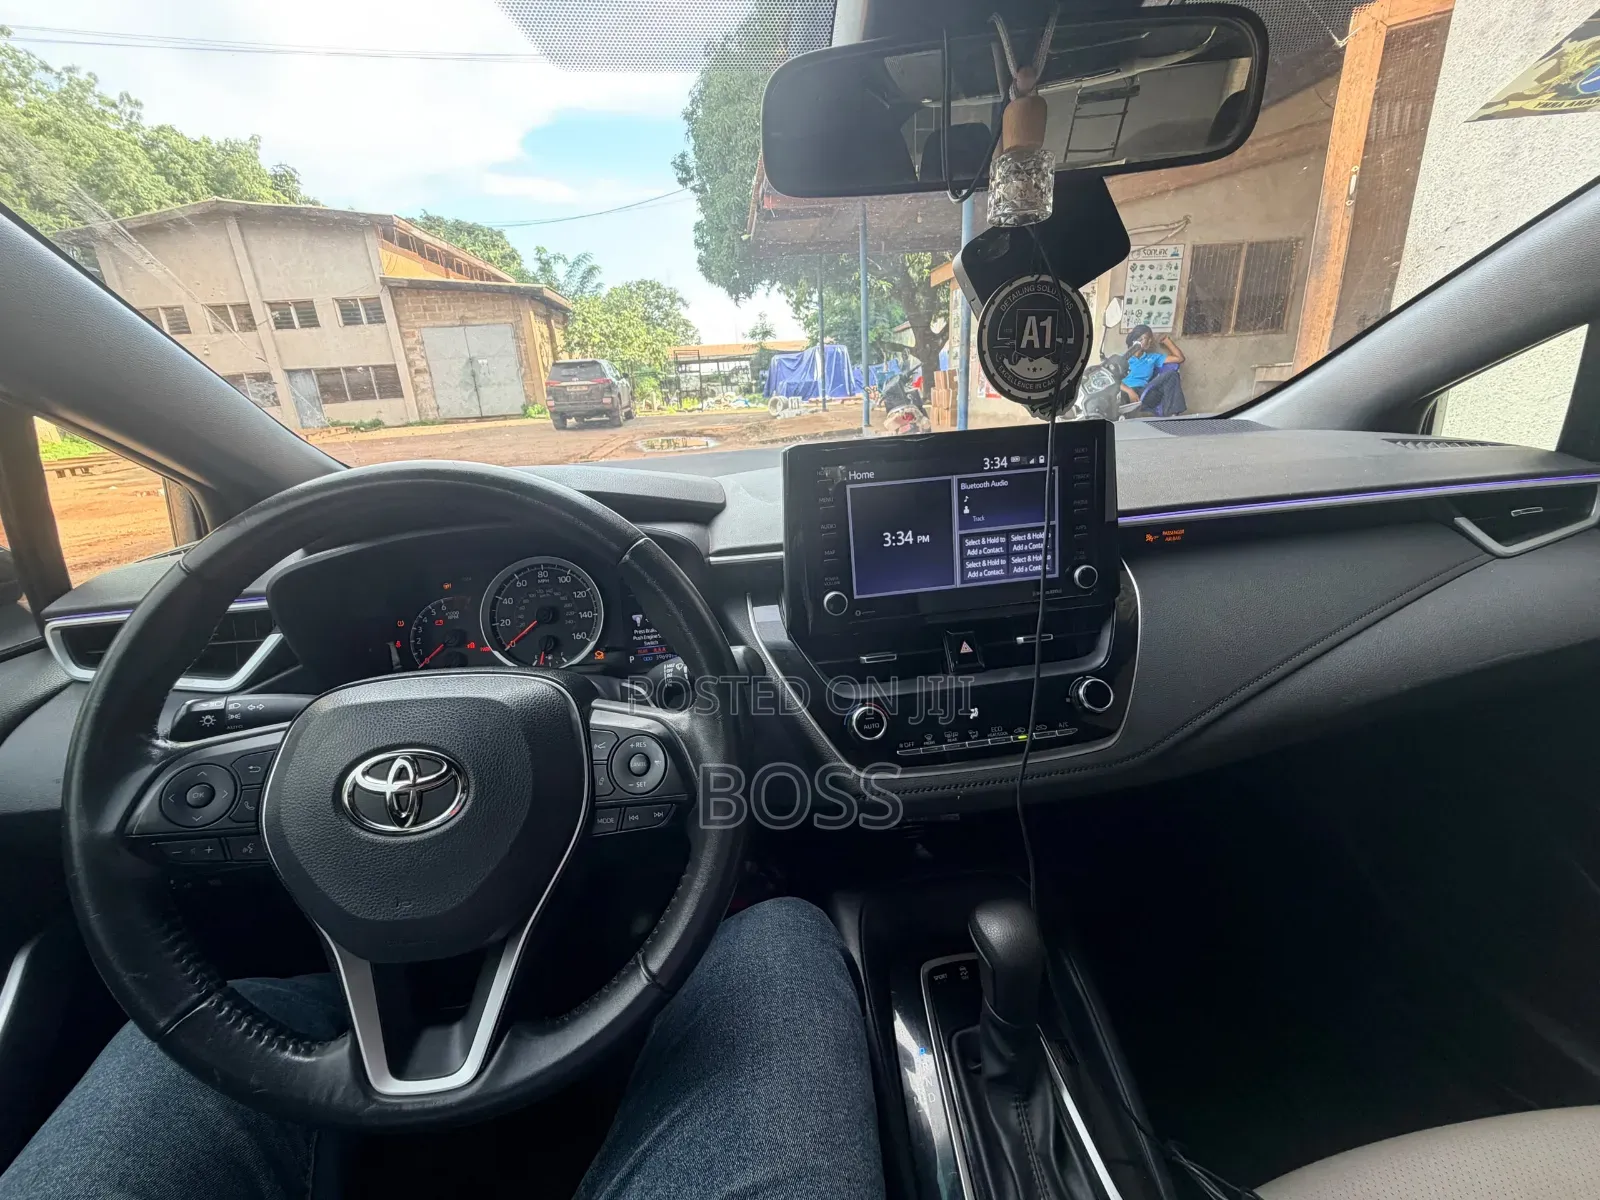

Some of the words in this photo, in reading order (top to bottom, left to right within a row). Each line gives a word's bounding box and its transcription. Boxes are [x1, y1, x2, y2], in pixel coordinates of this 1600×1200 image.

[1001, 284, 1035, 312] DETAILING
[1036, 284, 1074, 310] SOLUNS
[1020, 316, 1053, 348] A1
[999, 366, 1034, 390] EXCELLENCE
[1034, 382, 1042, 390] IN
[1042, 378, 1056, 388] CAR
[983, 456, 1008, 470] 3:34
[848, 470, 874, 480] Home
[960, 480, 990, 490] Bluetooth
[883, 530, 914, 547] 3:34
[917, 534, 930, 544] PM
